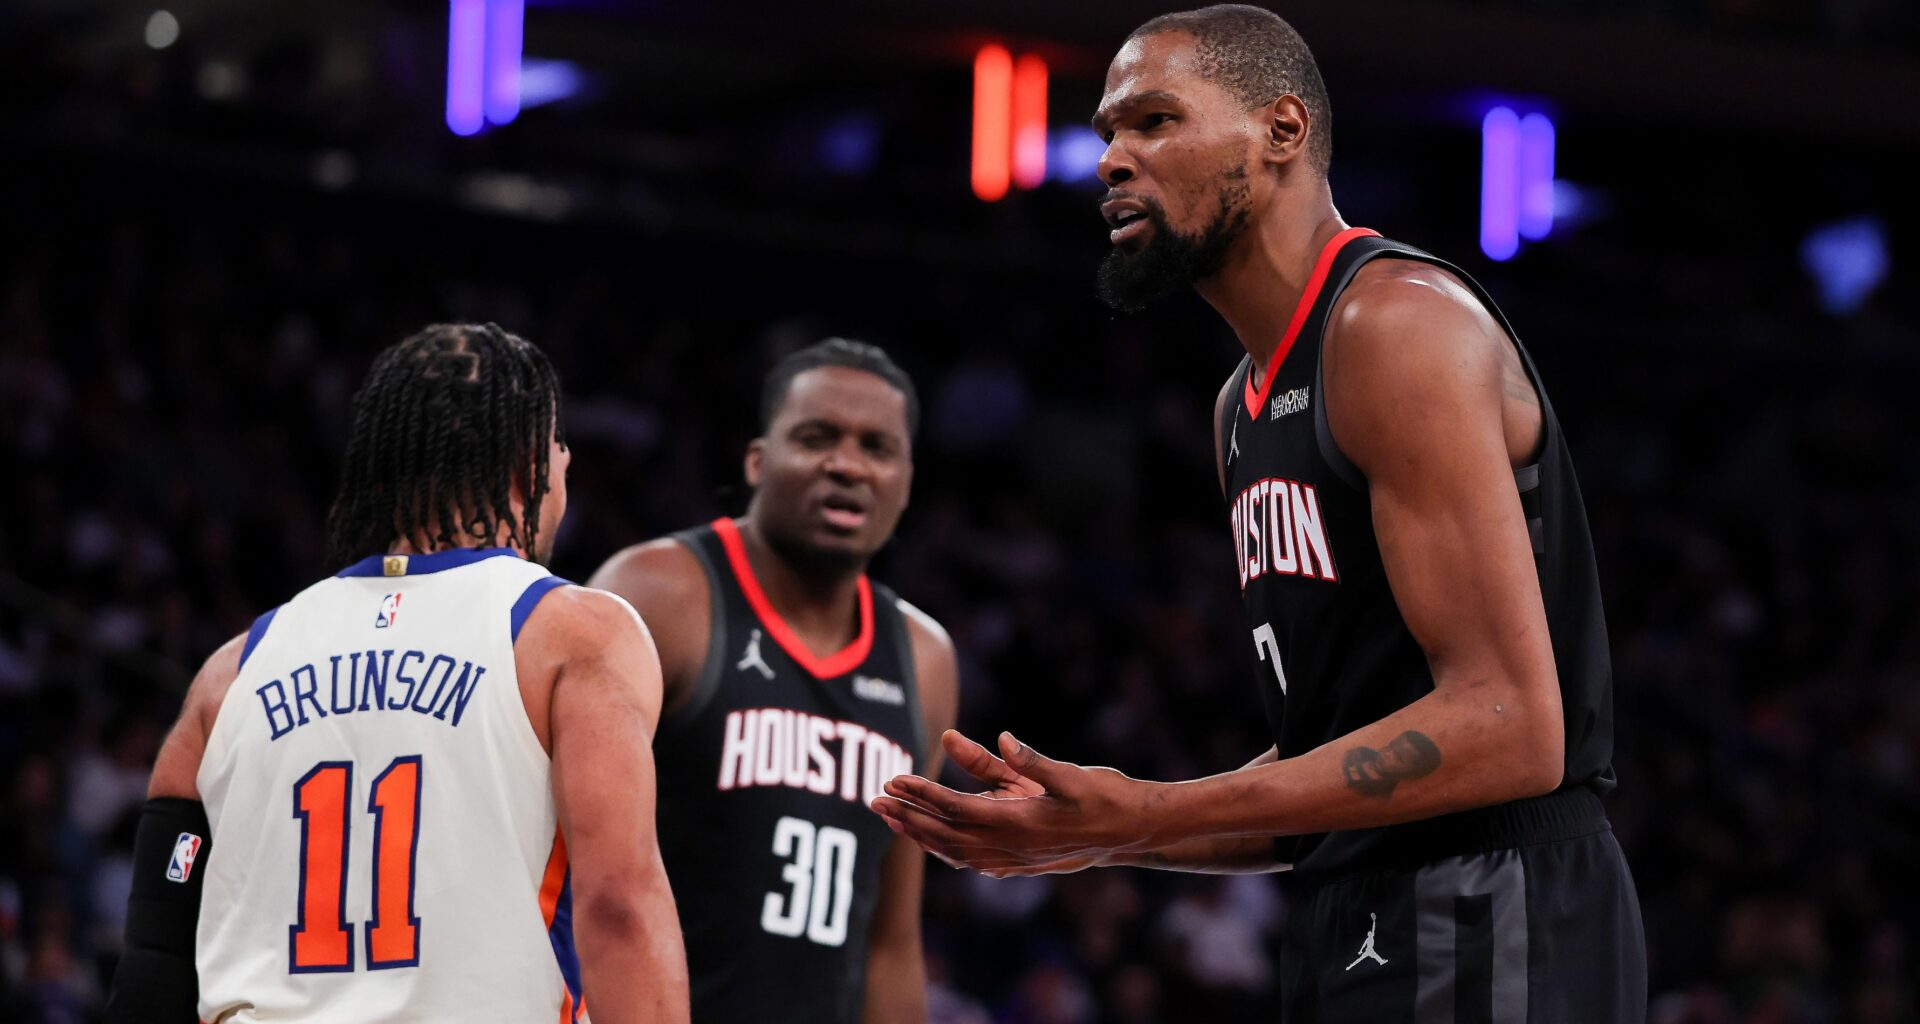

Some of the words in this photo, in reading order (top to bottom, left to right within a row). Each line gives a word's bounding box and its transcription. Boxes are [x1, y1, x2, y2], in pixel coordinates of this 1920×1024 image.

[1271, 386, 1309, 409] MEMORIAL
[1271, 397, 1308, 421] HERMANN
[256, 649, 486, 741] BRUNSON
[1252, 622, 1287, 696] 7
[289, 754, 423, 975] 11
[761, 815, 857, 947] 30
